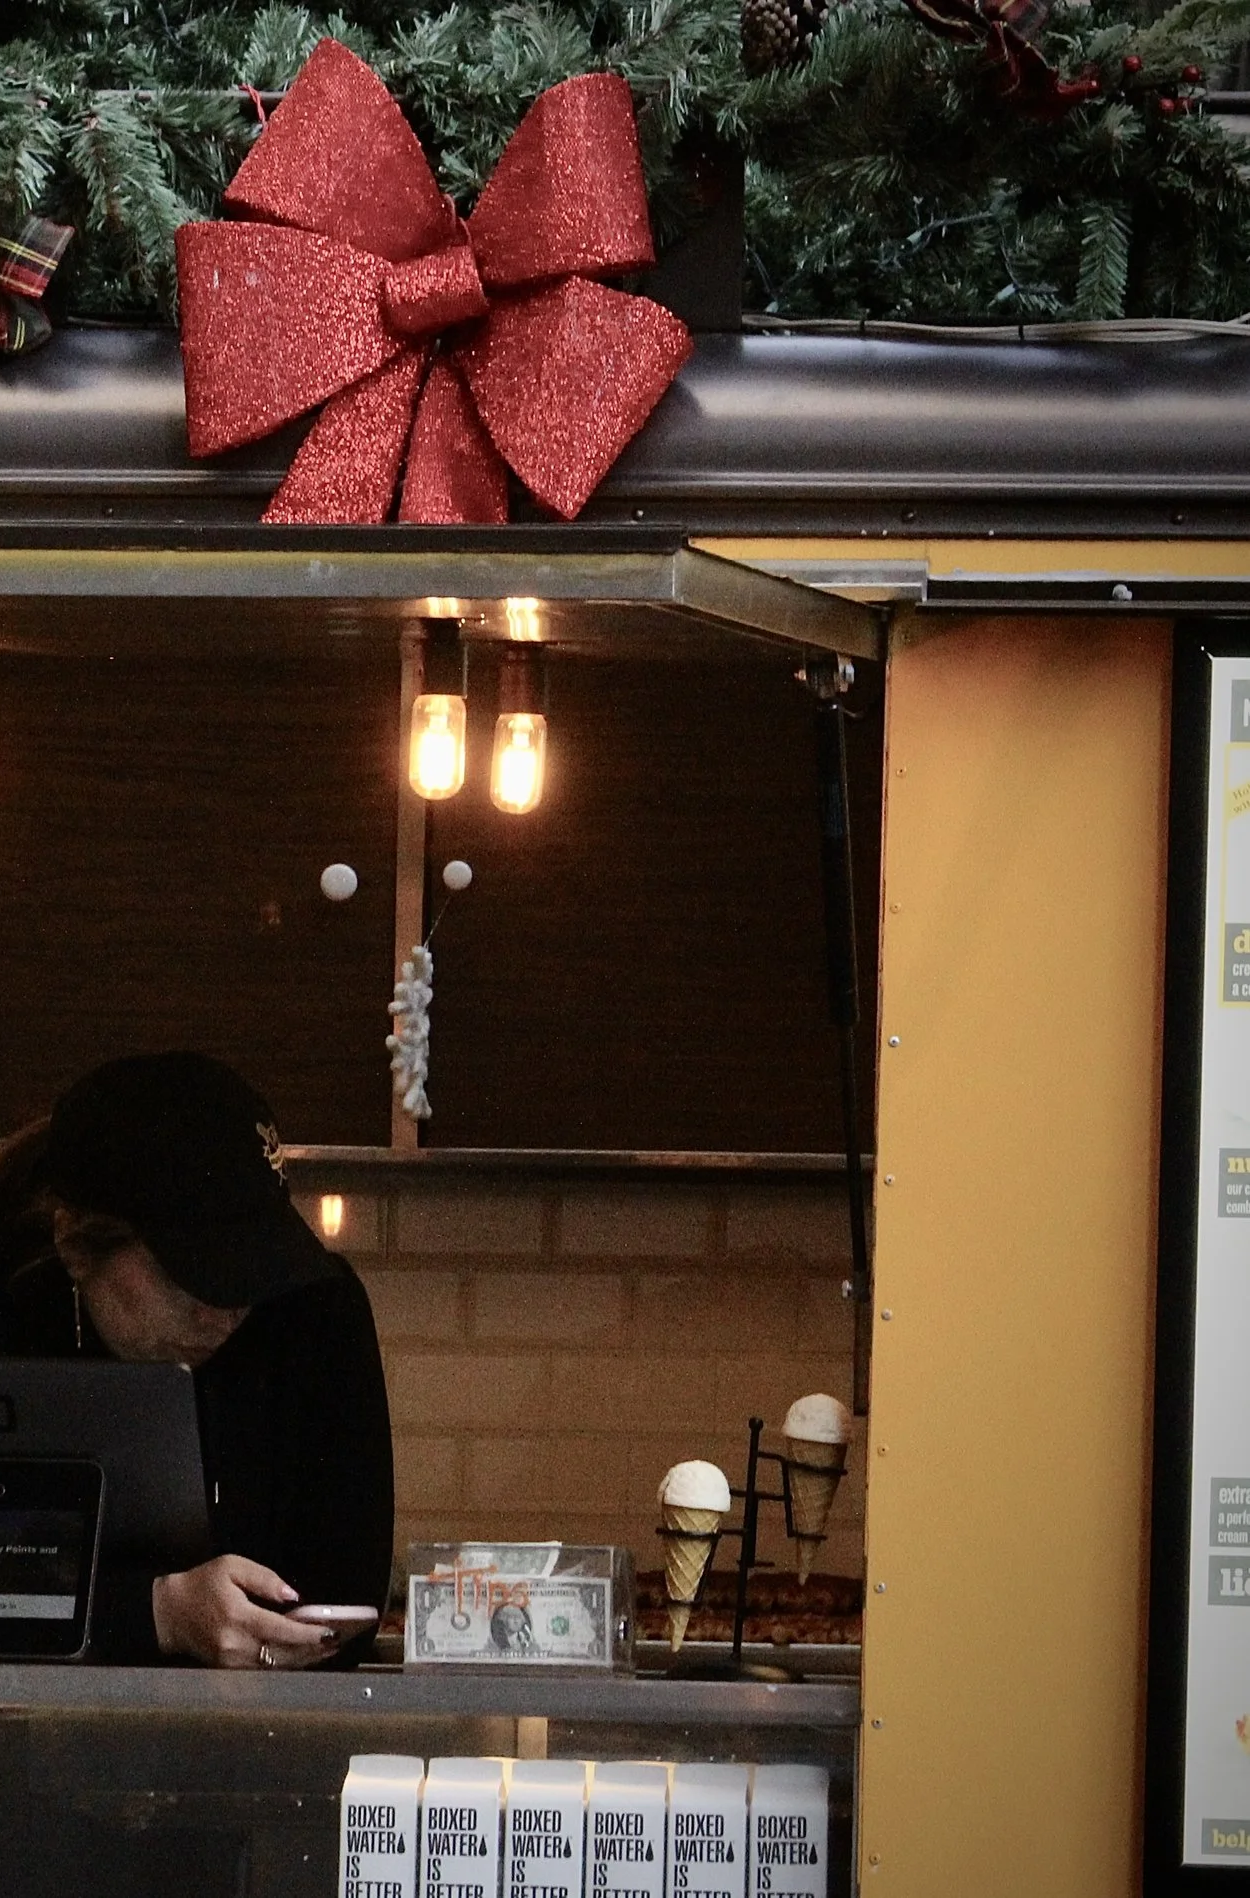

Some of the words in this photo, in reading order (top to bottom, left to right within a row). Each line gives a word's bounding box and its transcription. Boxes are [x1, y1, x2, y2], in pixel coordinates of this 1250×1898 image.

[5, 1545, 36, 1554] Points
[39, 1546, 58, 1554] and
[348, 1805, 395, 1828] BOXED
[428, 1807, 477, 1831] BOXED
[512, 1809, 561, 1833] BOXED
[594, 1812, 644, 1836] BOXED
[675, 1814, 724, 1837] BOXED
[757, 1816, 807, 1839] BOXED
[347, 1831, 396, 1854] WATER
[427, 1833, 478, 1857] WATER
[512, 1835, 562, 1858] WATER
[594, 1838, 644, 1862] WATER
[675, 1840, 725, 1863] WATER
[757, 1842, 808, 1865] WATER
[346, 1856, 360, 1878] IS
[427, 1858, 441, 1881] IS
[511, 1860, 525, 1883] IS
[593, 1863, 607, 1886] IS
[674, 1865, 688, 1887] IS
[757, 1866, 771, 1889] IS
[345, 1881, 402, 1898] BETTER
